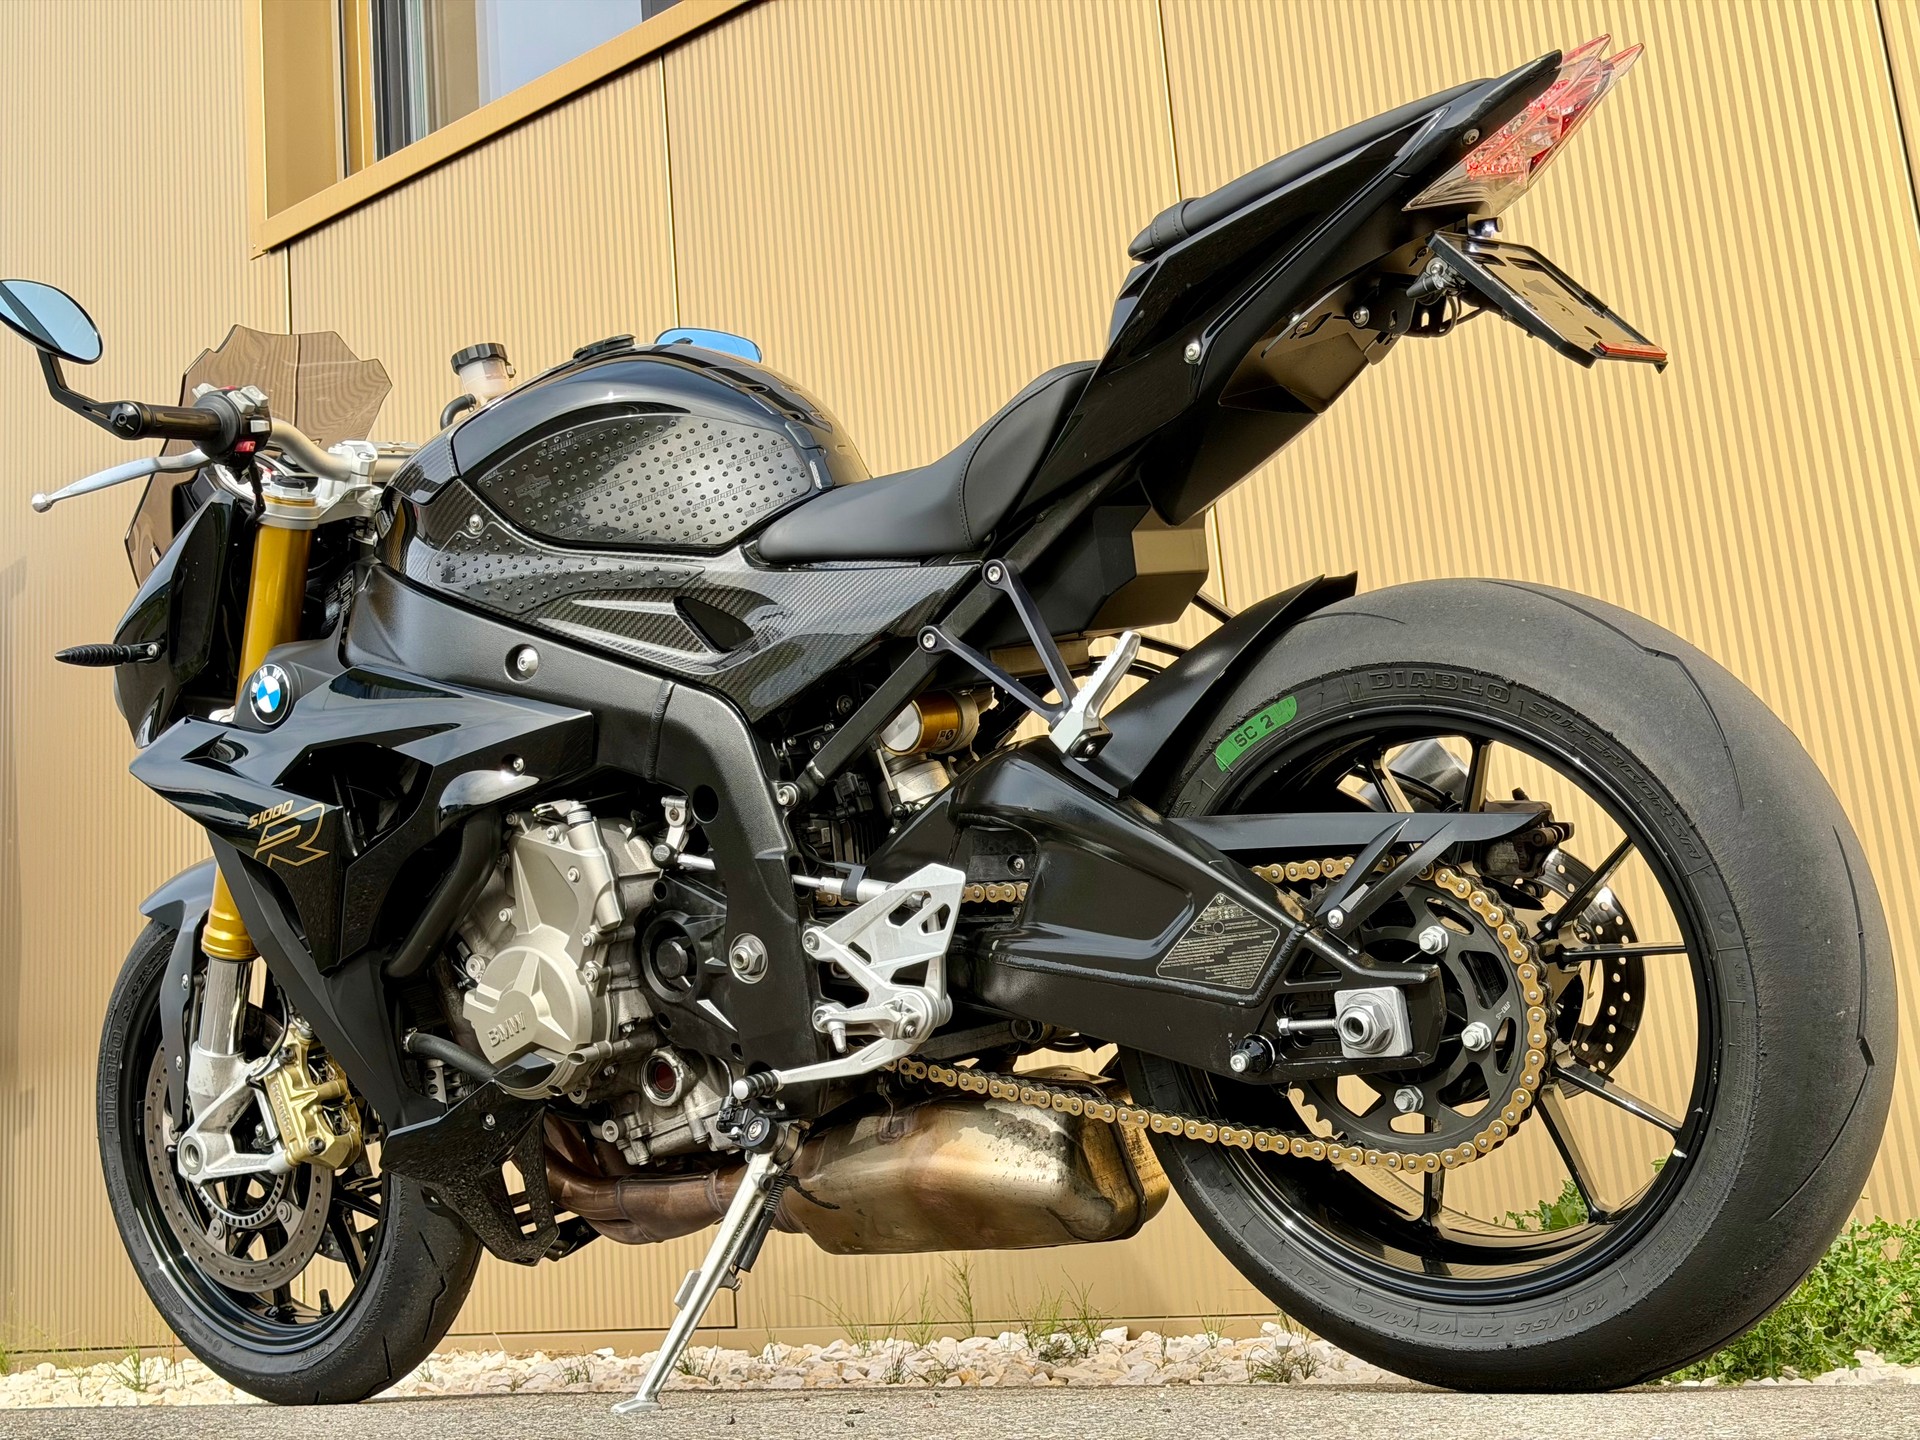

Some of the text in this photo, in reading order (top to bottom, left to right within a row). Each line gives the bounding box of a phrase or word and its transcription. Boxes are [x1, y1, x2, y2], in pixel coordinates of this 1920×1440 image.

[1234, 714, 1275, 748] SC 2
[1367, 670, 1703, 861] DIABLO SUPERCORSA
[247, 799, 294, 830] S1000
[488, 1012, 526, 1047] BMW
[104, 1028, 124, 1129] DIABLO
[270, 1080, 292, 1136] brembo
[1512, 1295, 1608, 1335] 190/55
